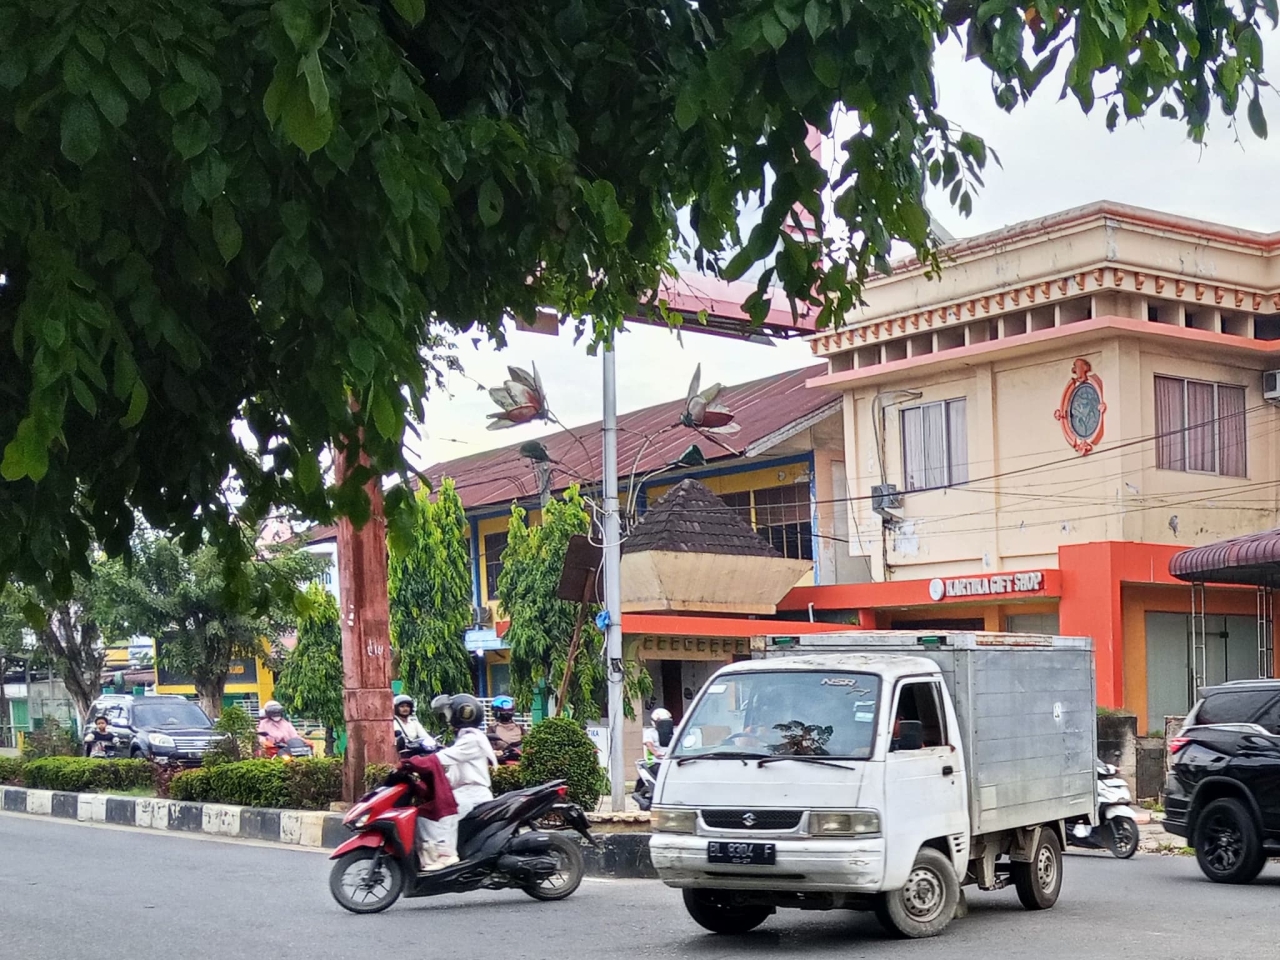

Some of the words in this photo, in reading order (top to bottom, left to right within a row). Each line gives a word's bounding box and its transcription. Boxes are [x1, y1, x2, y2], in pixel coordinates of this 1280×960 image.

[990, 576, 1013, 594] GIFT
[1014, 571, 1042, 592] SHOP
[709, 842, 724, 857] BL
[763, 844, 772, 858] F
